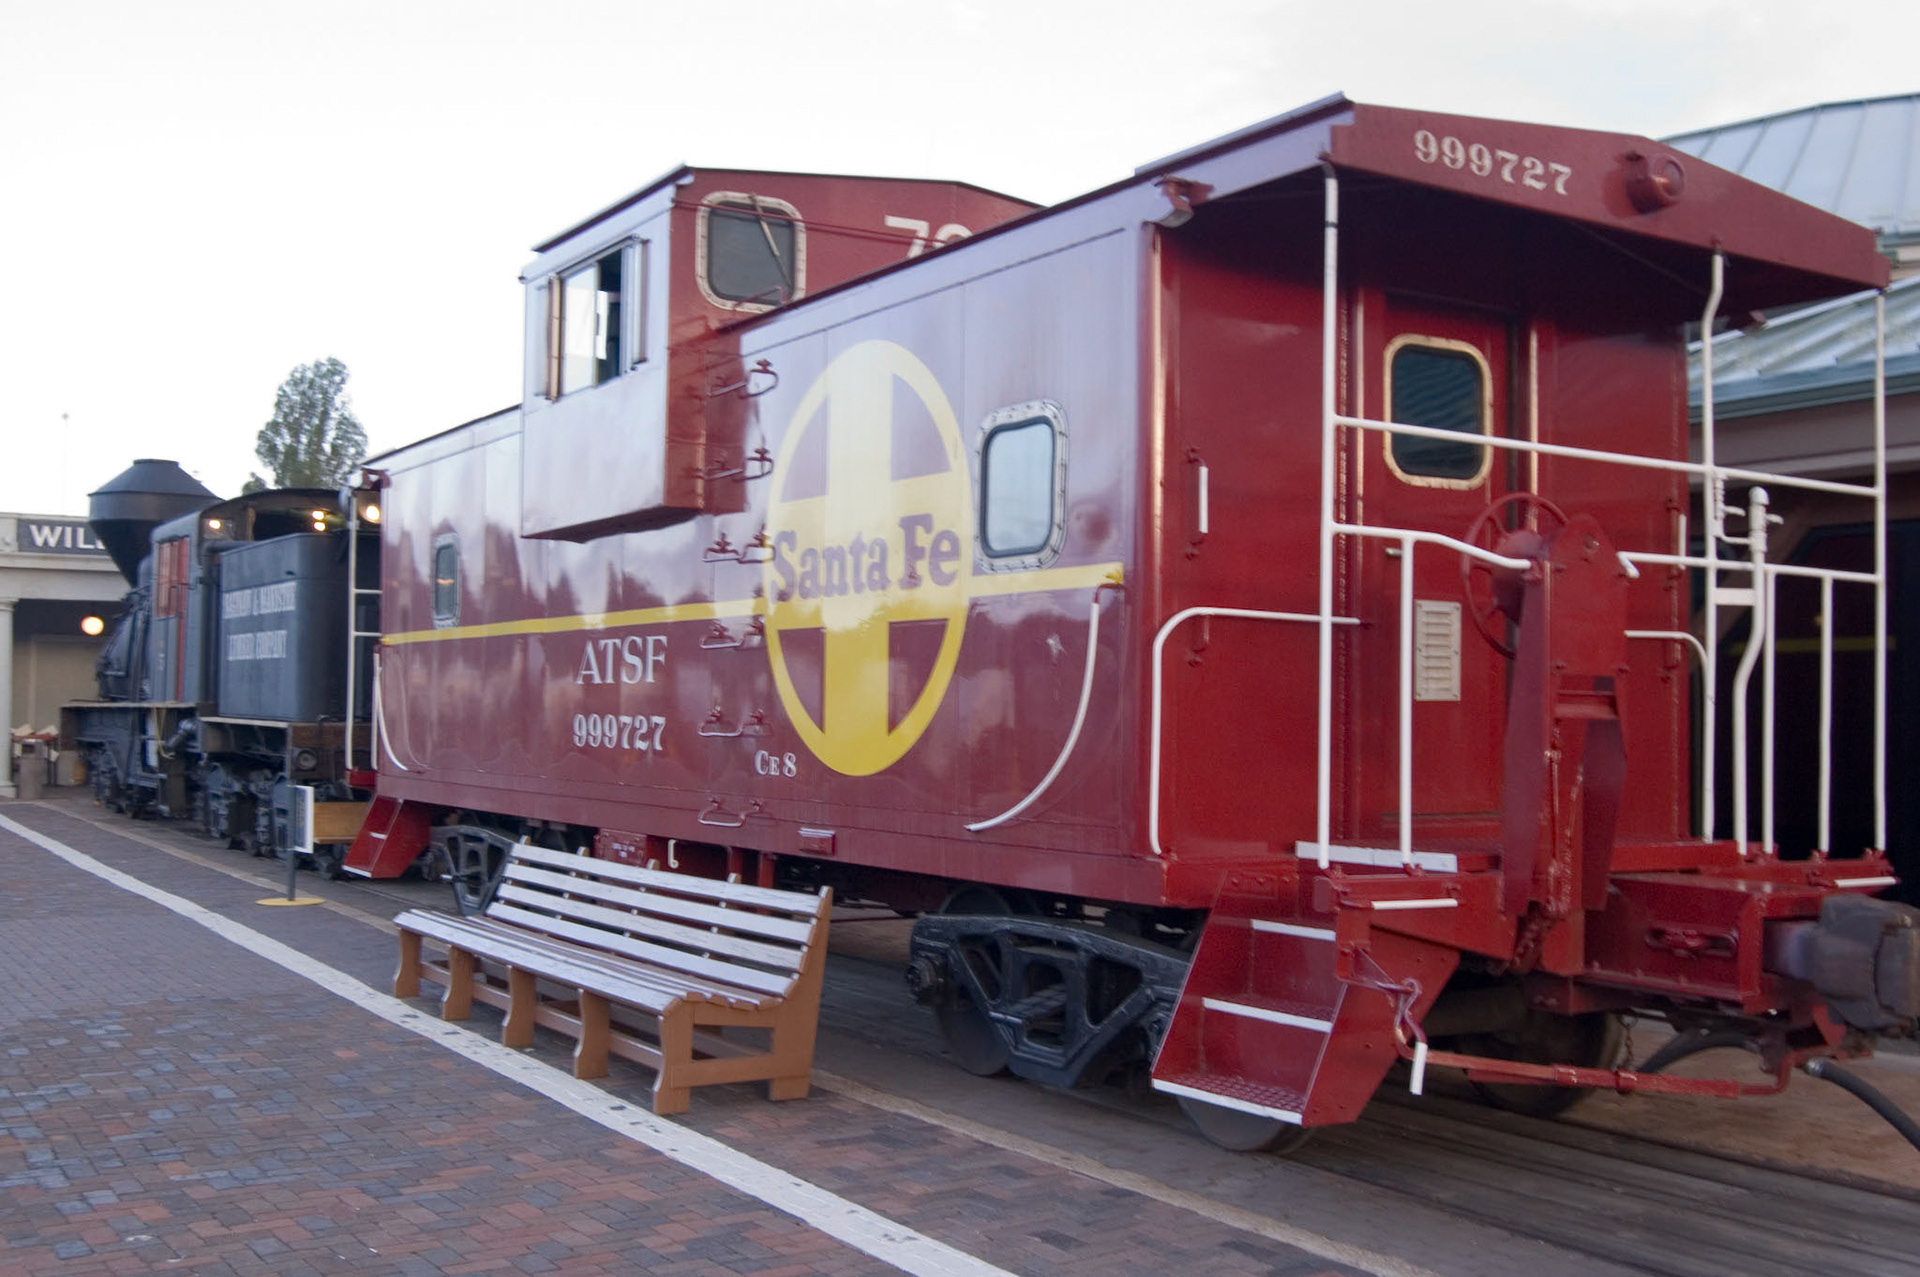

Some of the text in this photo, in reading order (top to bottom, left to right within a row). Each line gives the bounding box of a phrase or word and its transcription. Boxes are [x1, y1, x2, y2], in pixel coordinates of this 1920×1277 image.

[1414, 129, 1572, 196] 999727
[770, 512, 961, 605] Santa Fe
[575, 635, 668, 685] ATSF
[572, 713, 667, 751] 999727
